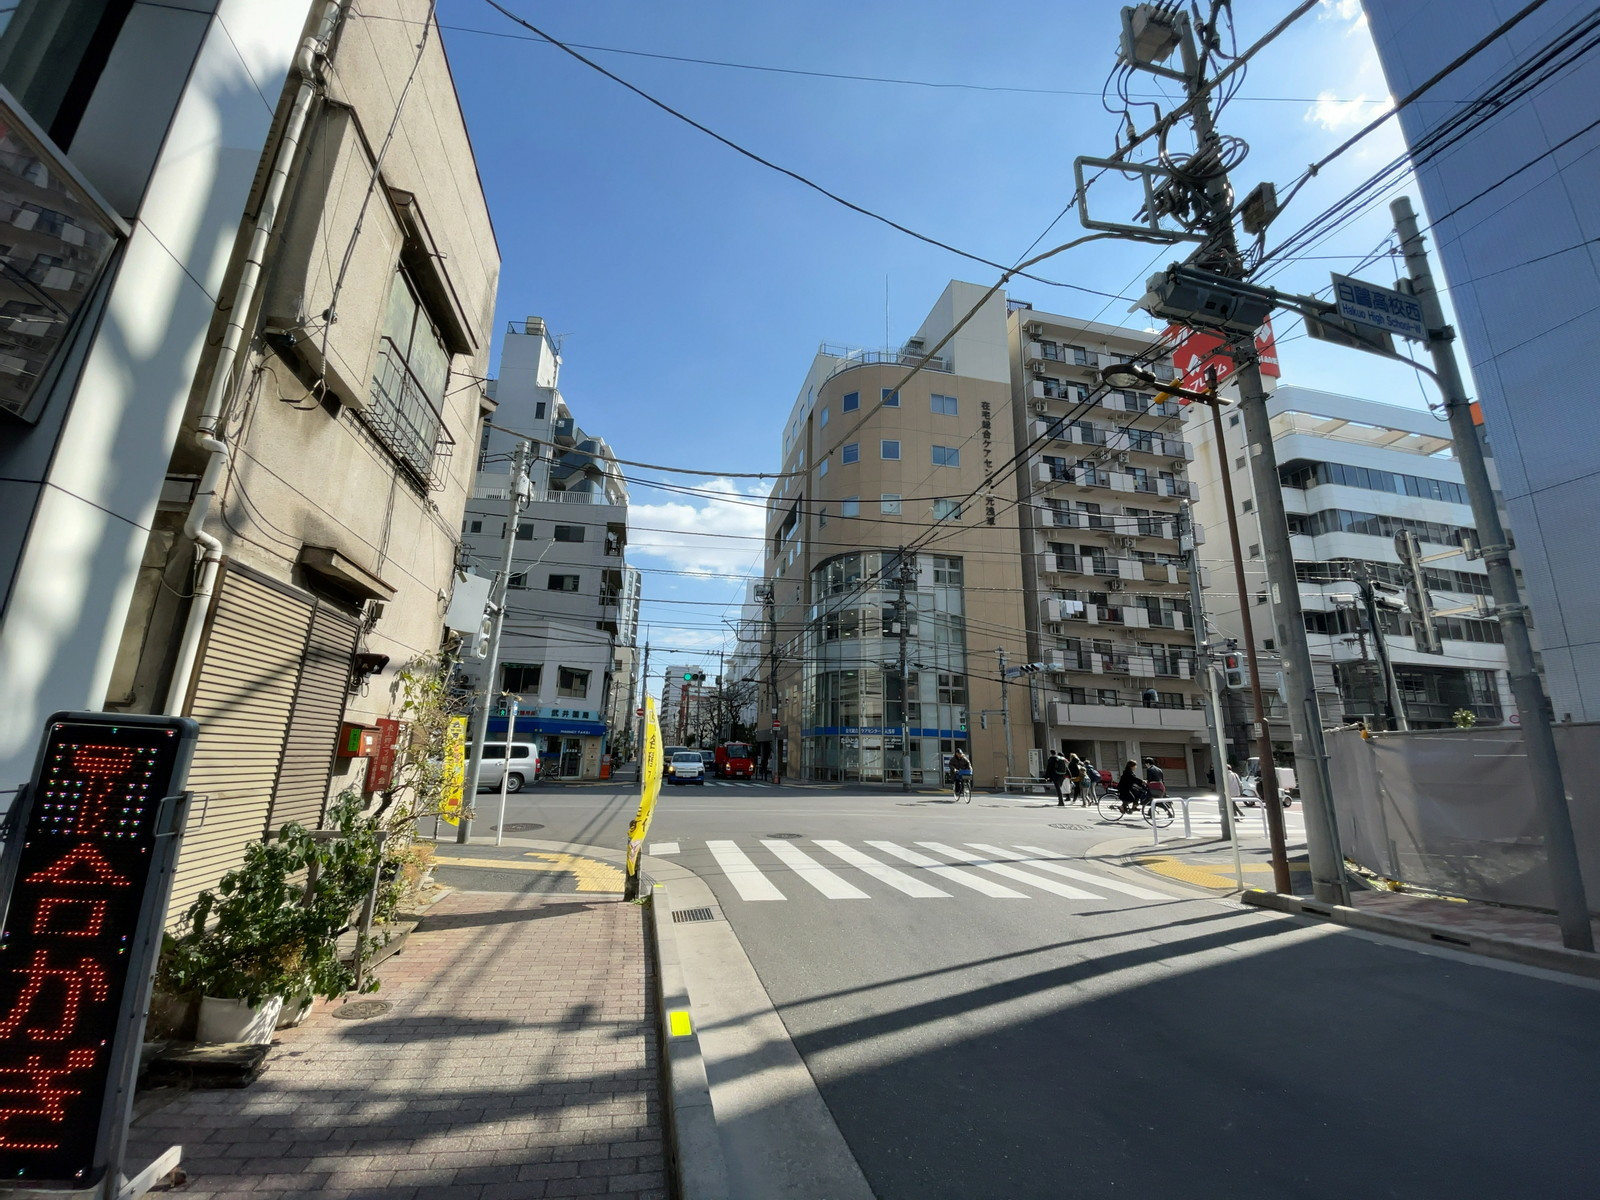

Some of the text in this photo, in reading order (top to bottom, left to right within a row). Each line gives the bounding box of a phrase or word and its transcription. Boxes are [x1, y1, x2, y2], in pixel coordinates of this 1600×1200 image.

[1342, 303, 1366, 319] Hakuo
[1368, 309, 1385, 325] High
[551, 710, 589, 719] 武井薬局
